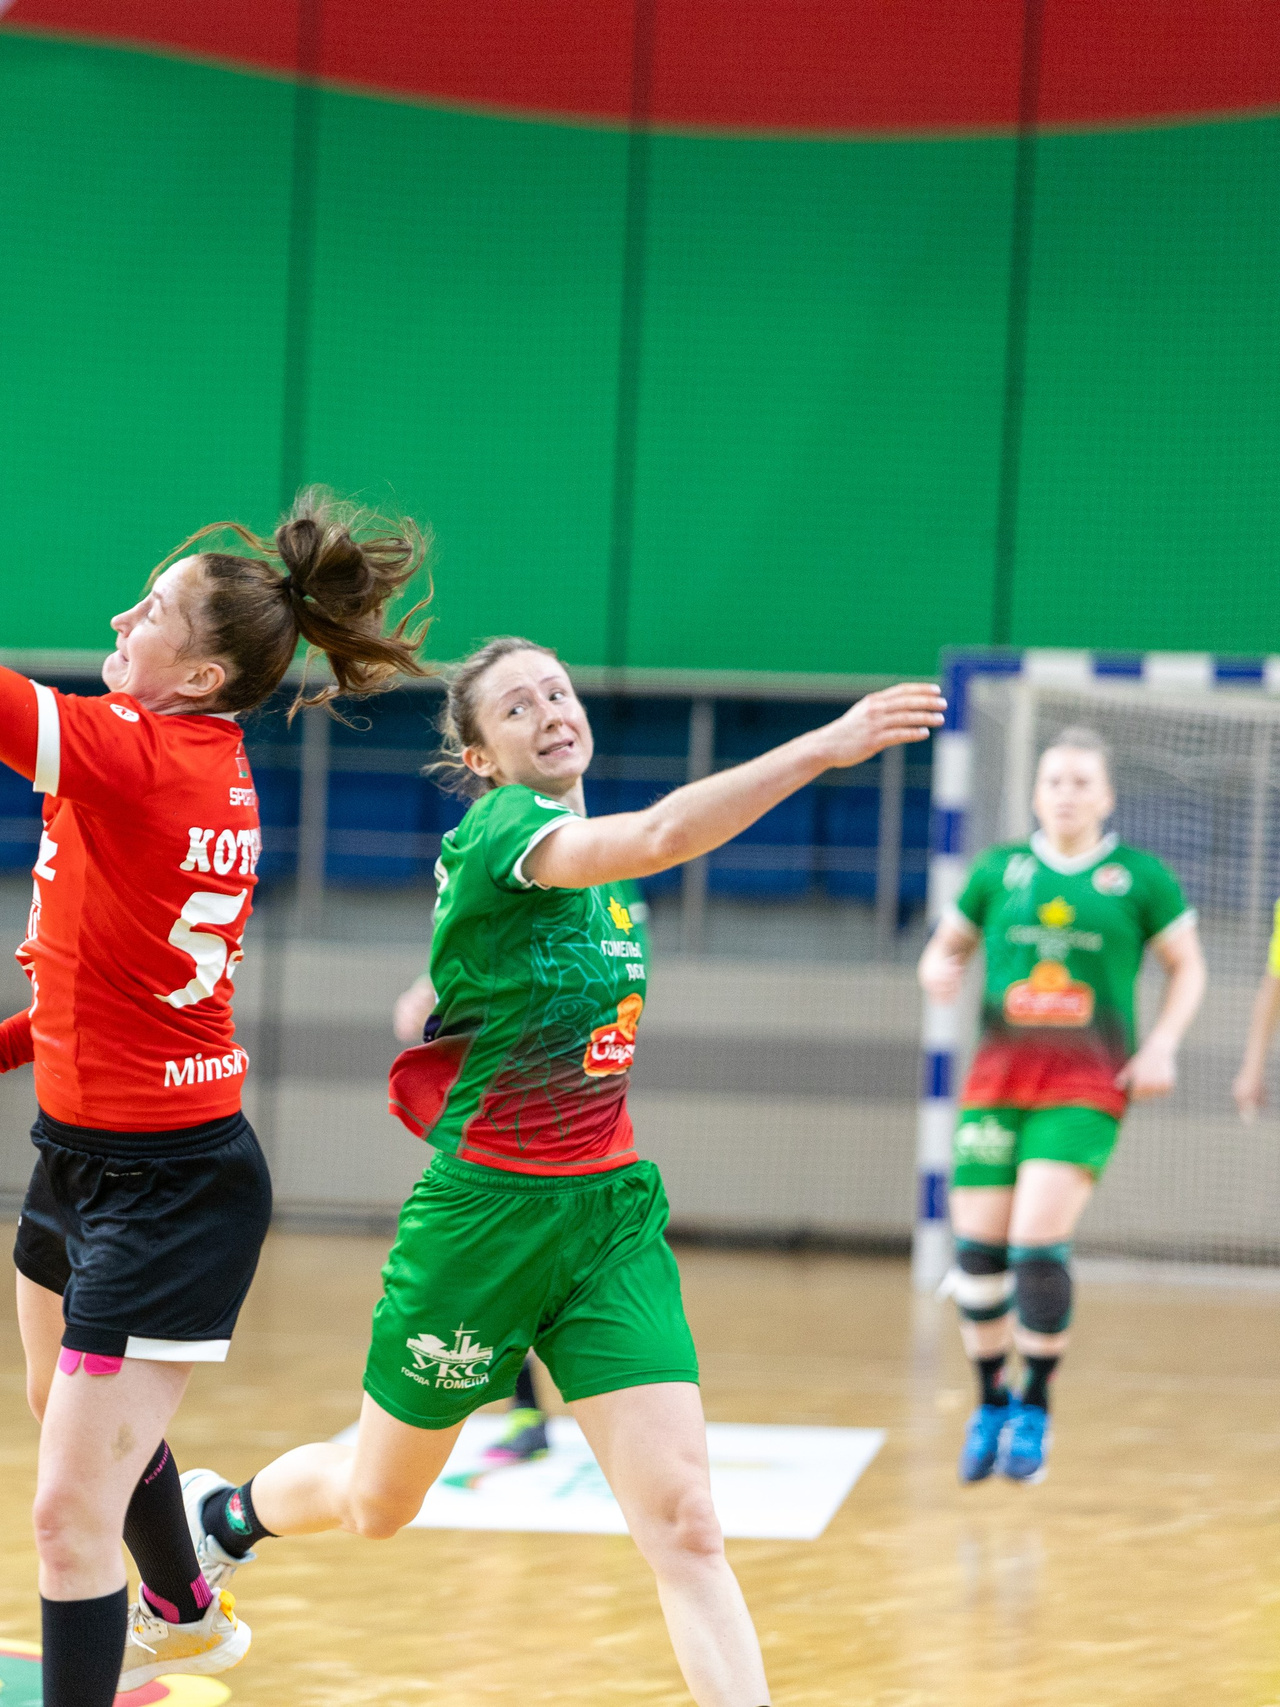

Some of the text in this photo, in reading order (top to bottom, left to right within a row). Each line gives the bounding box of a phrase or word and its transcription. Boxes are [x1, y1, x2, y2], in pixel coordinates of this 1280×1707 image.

[401, 1366, 490, 1389] ГОРОДА ГОМЕЛЯ
[411, 1352, 490, 1379] УКС
